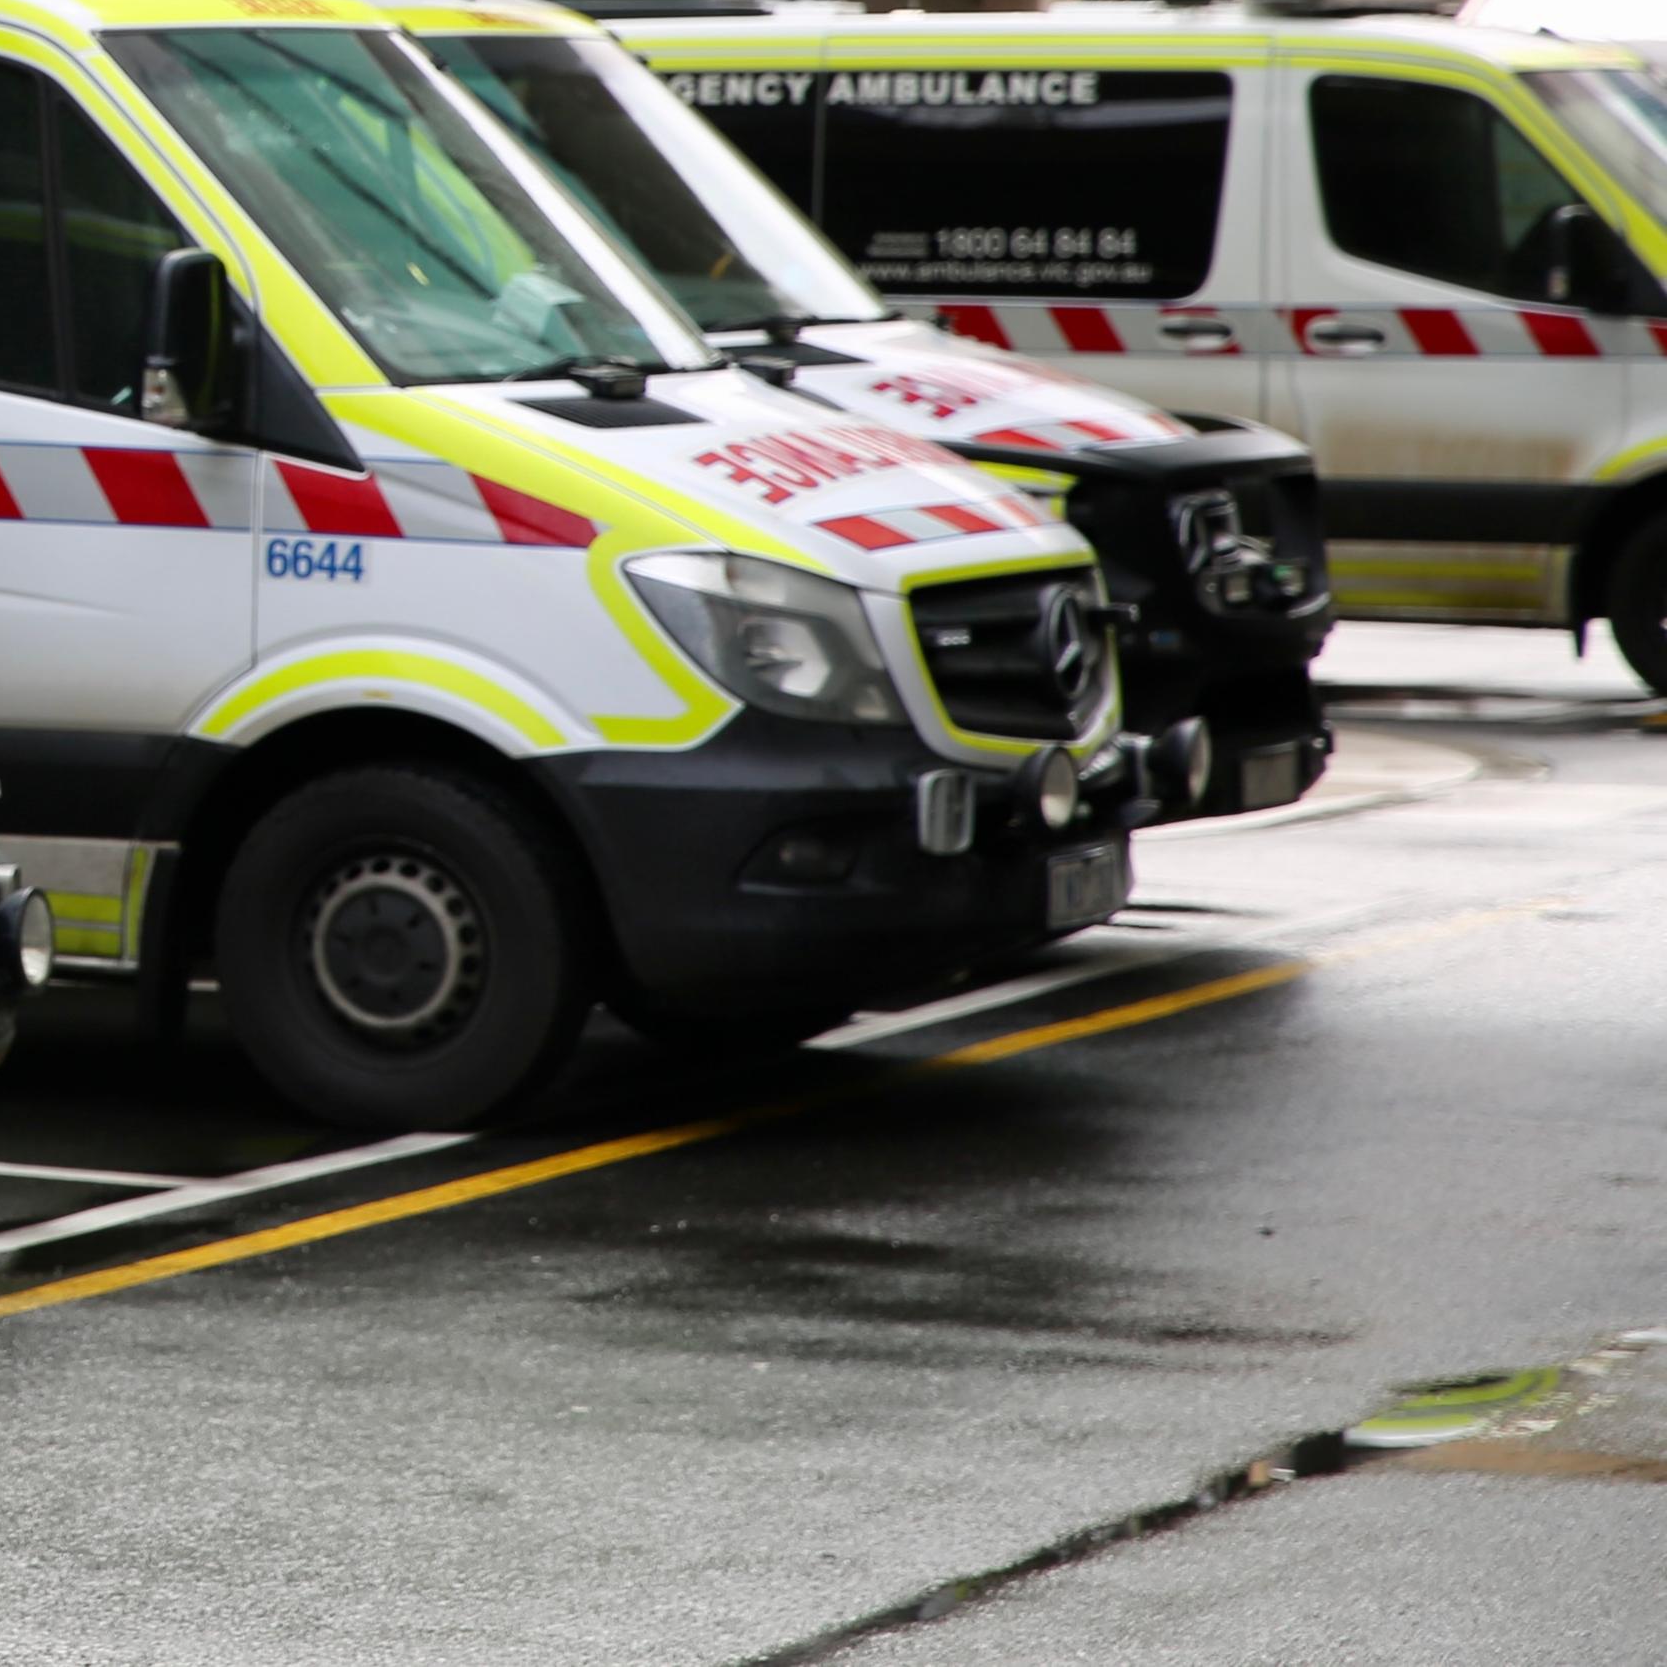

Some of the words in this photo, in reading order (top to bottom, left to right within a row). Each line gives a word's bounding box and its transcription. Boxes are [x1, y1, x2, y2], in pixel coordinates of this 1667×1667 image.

[824, 72, 1099, 105] AMBULANCE
[936, 227, 1007, 259] 1800
[267, 537, 365, 583] 6644
